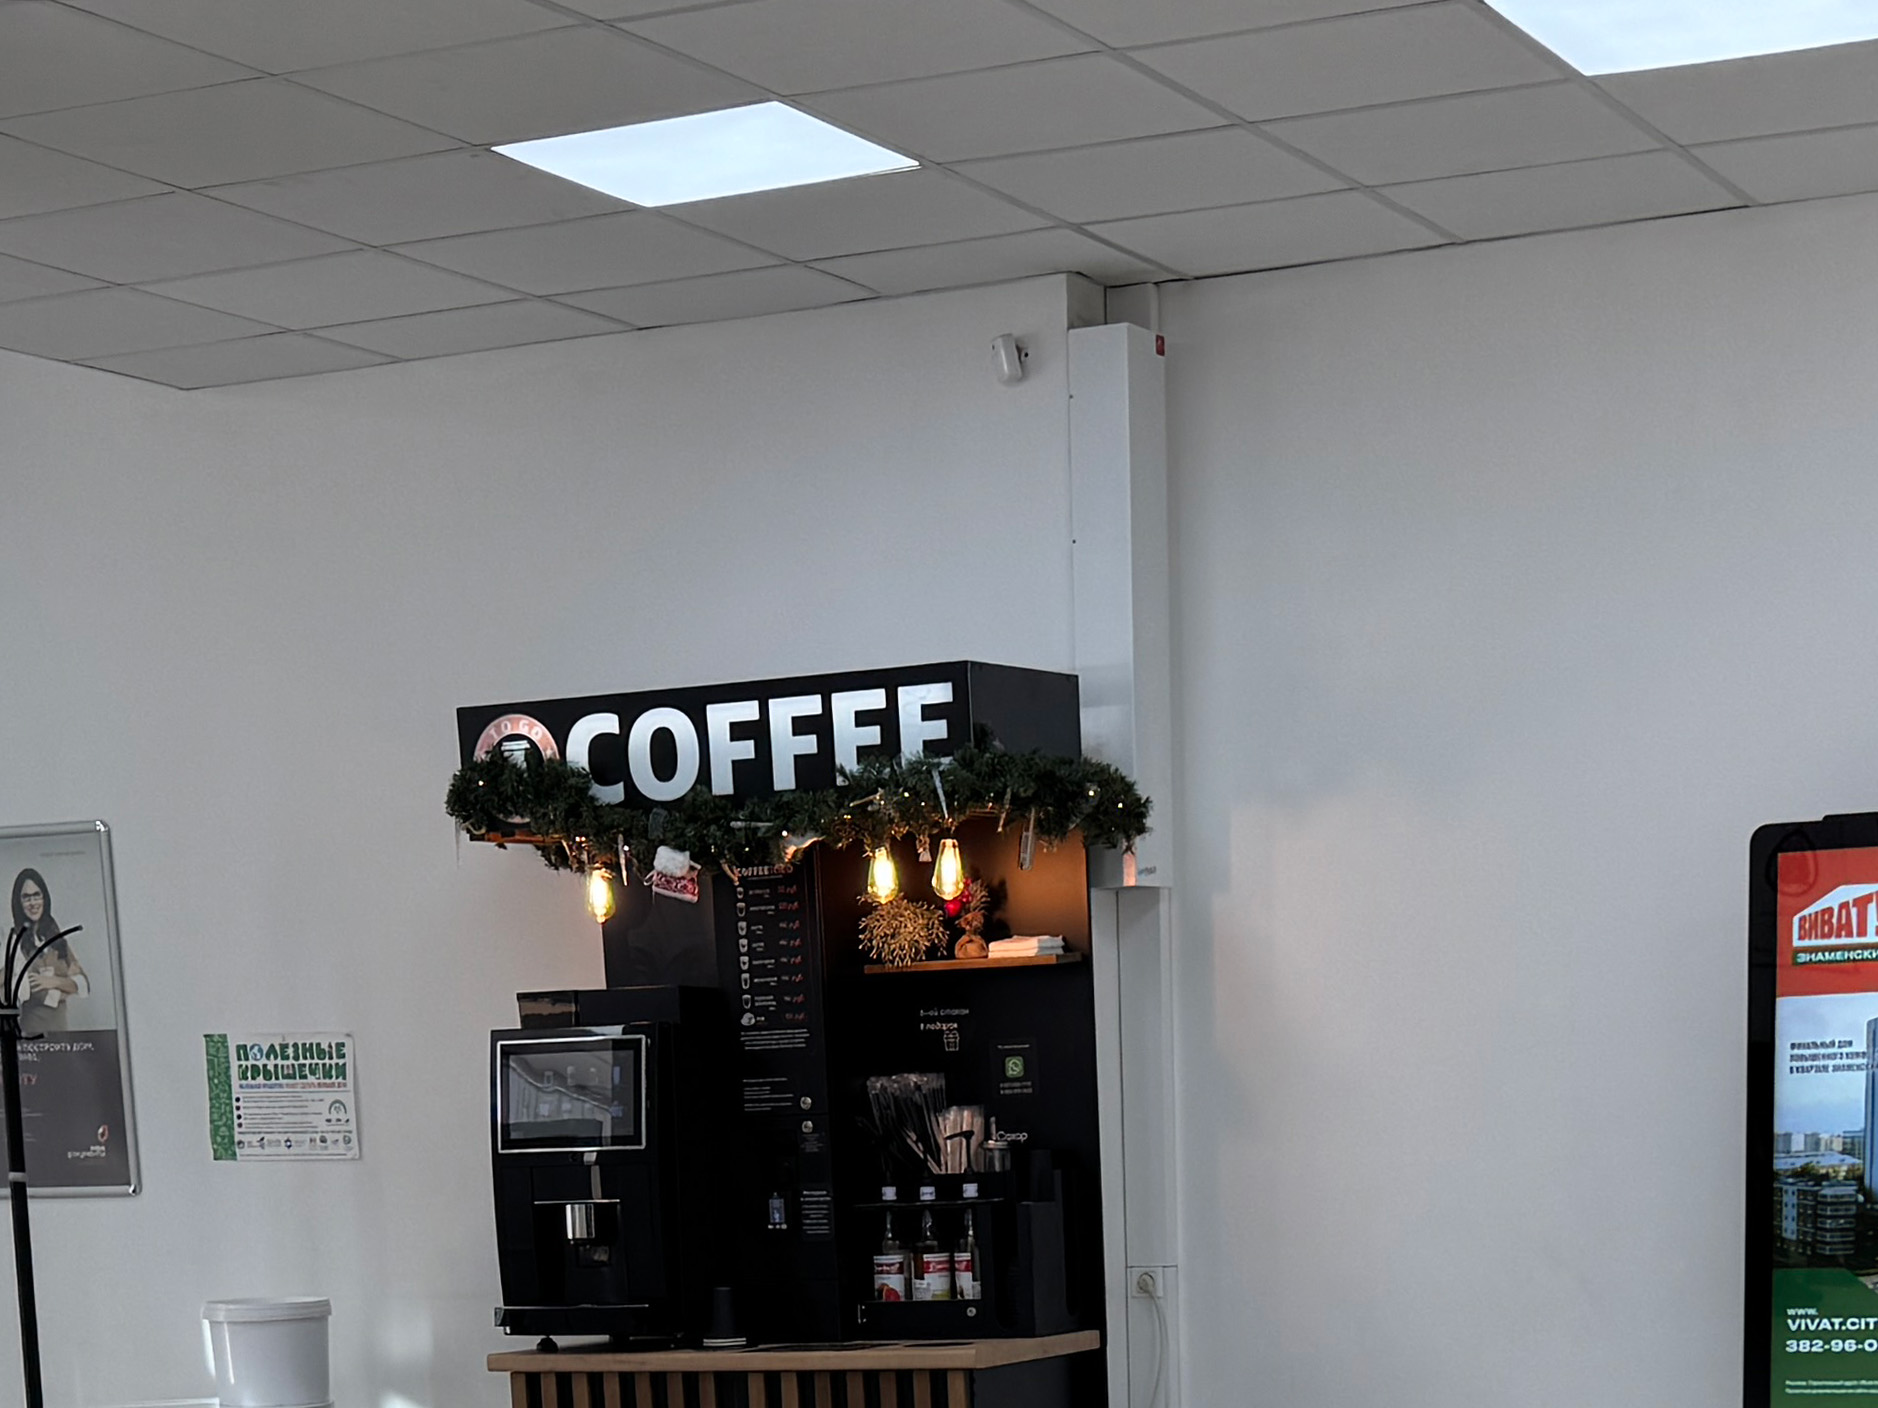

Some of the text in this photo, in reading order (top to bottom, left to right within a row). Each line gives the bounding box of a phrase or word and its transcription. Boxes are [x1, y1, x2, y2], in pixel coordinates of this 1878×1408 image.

[489, 719, 543, 740] TO GO
[565, 682, 954, 806] COFFEE
[235, 1042, 346, 1062] ПОЛЕЗНЫЕ
[237, 1062, 347, 1081] КРЫШЕЧКИ
